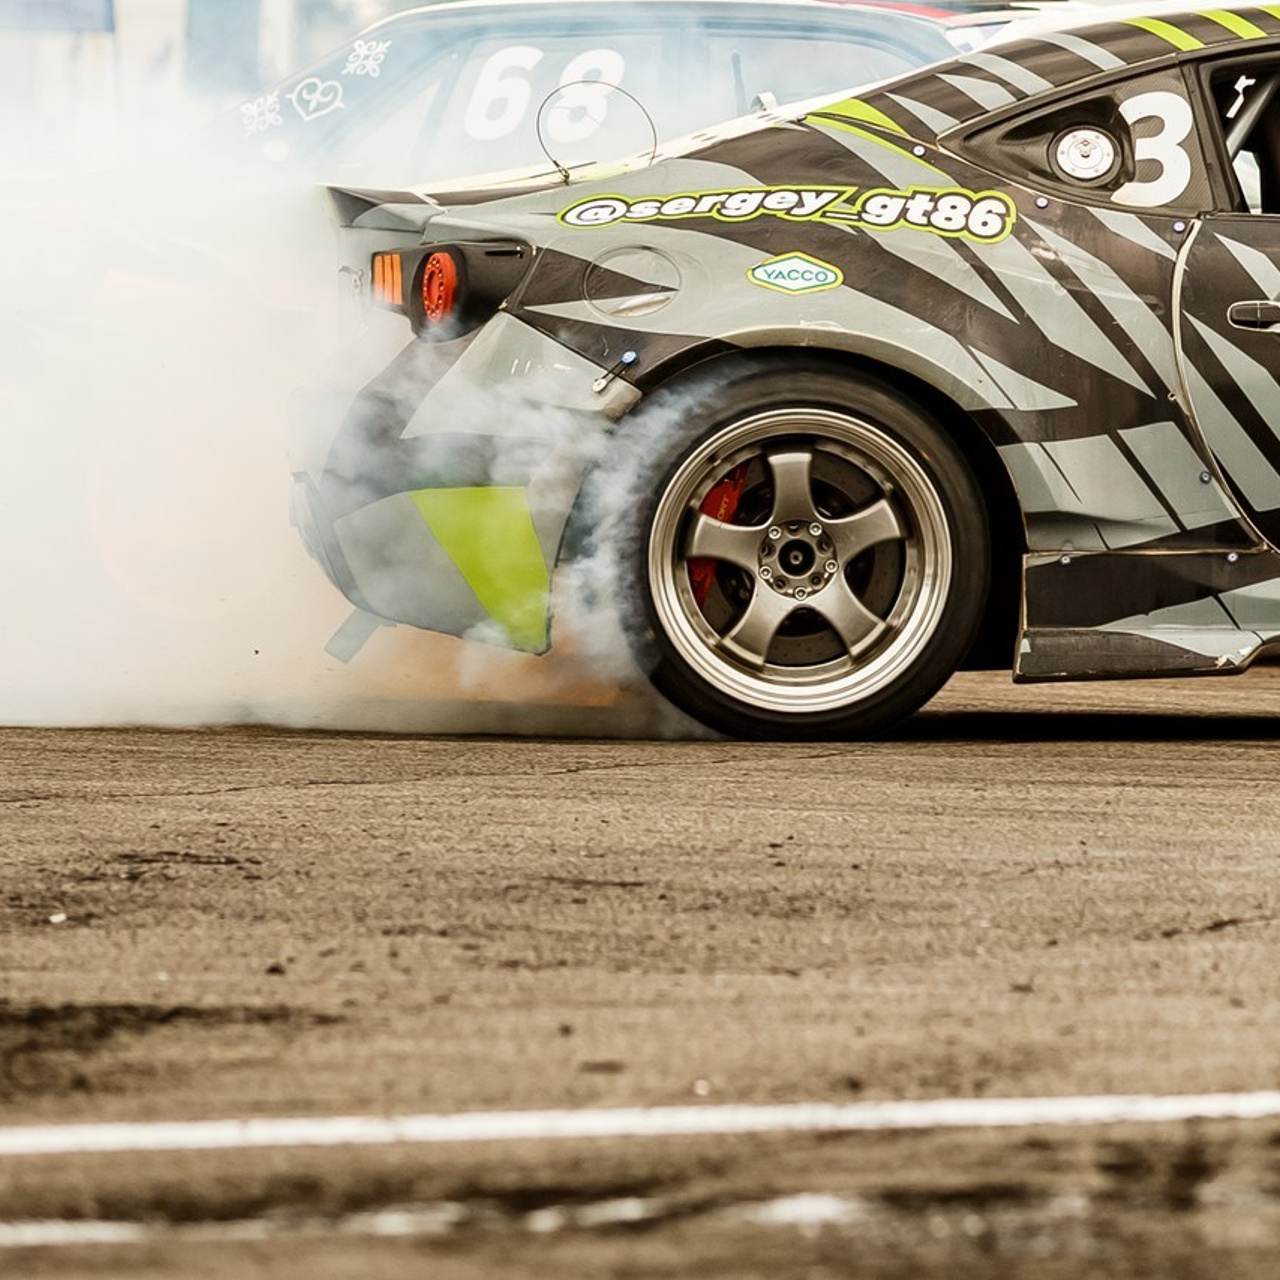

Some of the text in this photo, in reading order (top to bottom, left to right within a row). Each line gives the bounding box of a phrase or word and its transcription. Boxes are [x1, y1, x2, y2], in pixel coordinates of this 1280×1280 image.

[464, 45, 625, 143] 68
[1110, 91, 1194, 207] 3
[563, 189, 1007, 236] @sergey_gt86
[763, 268, 828, 283] YACCO
